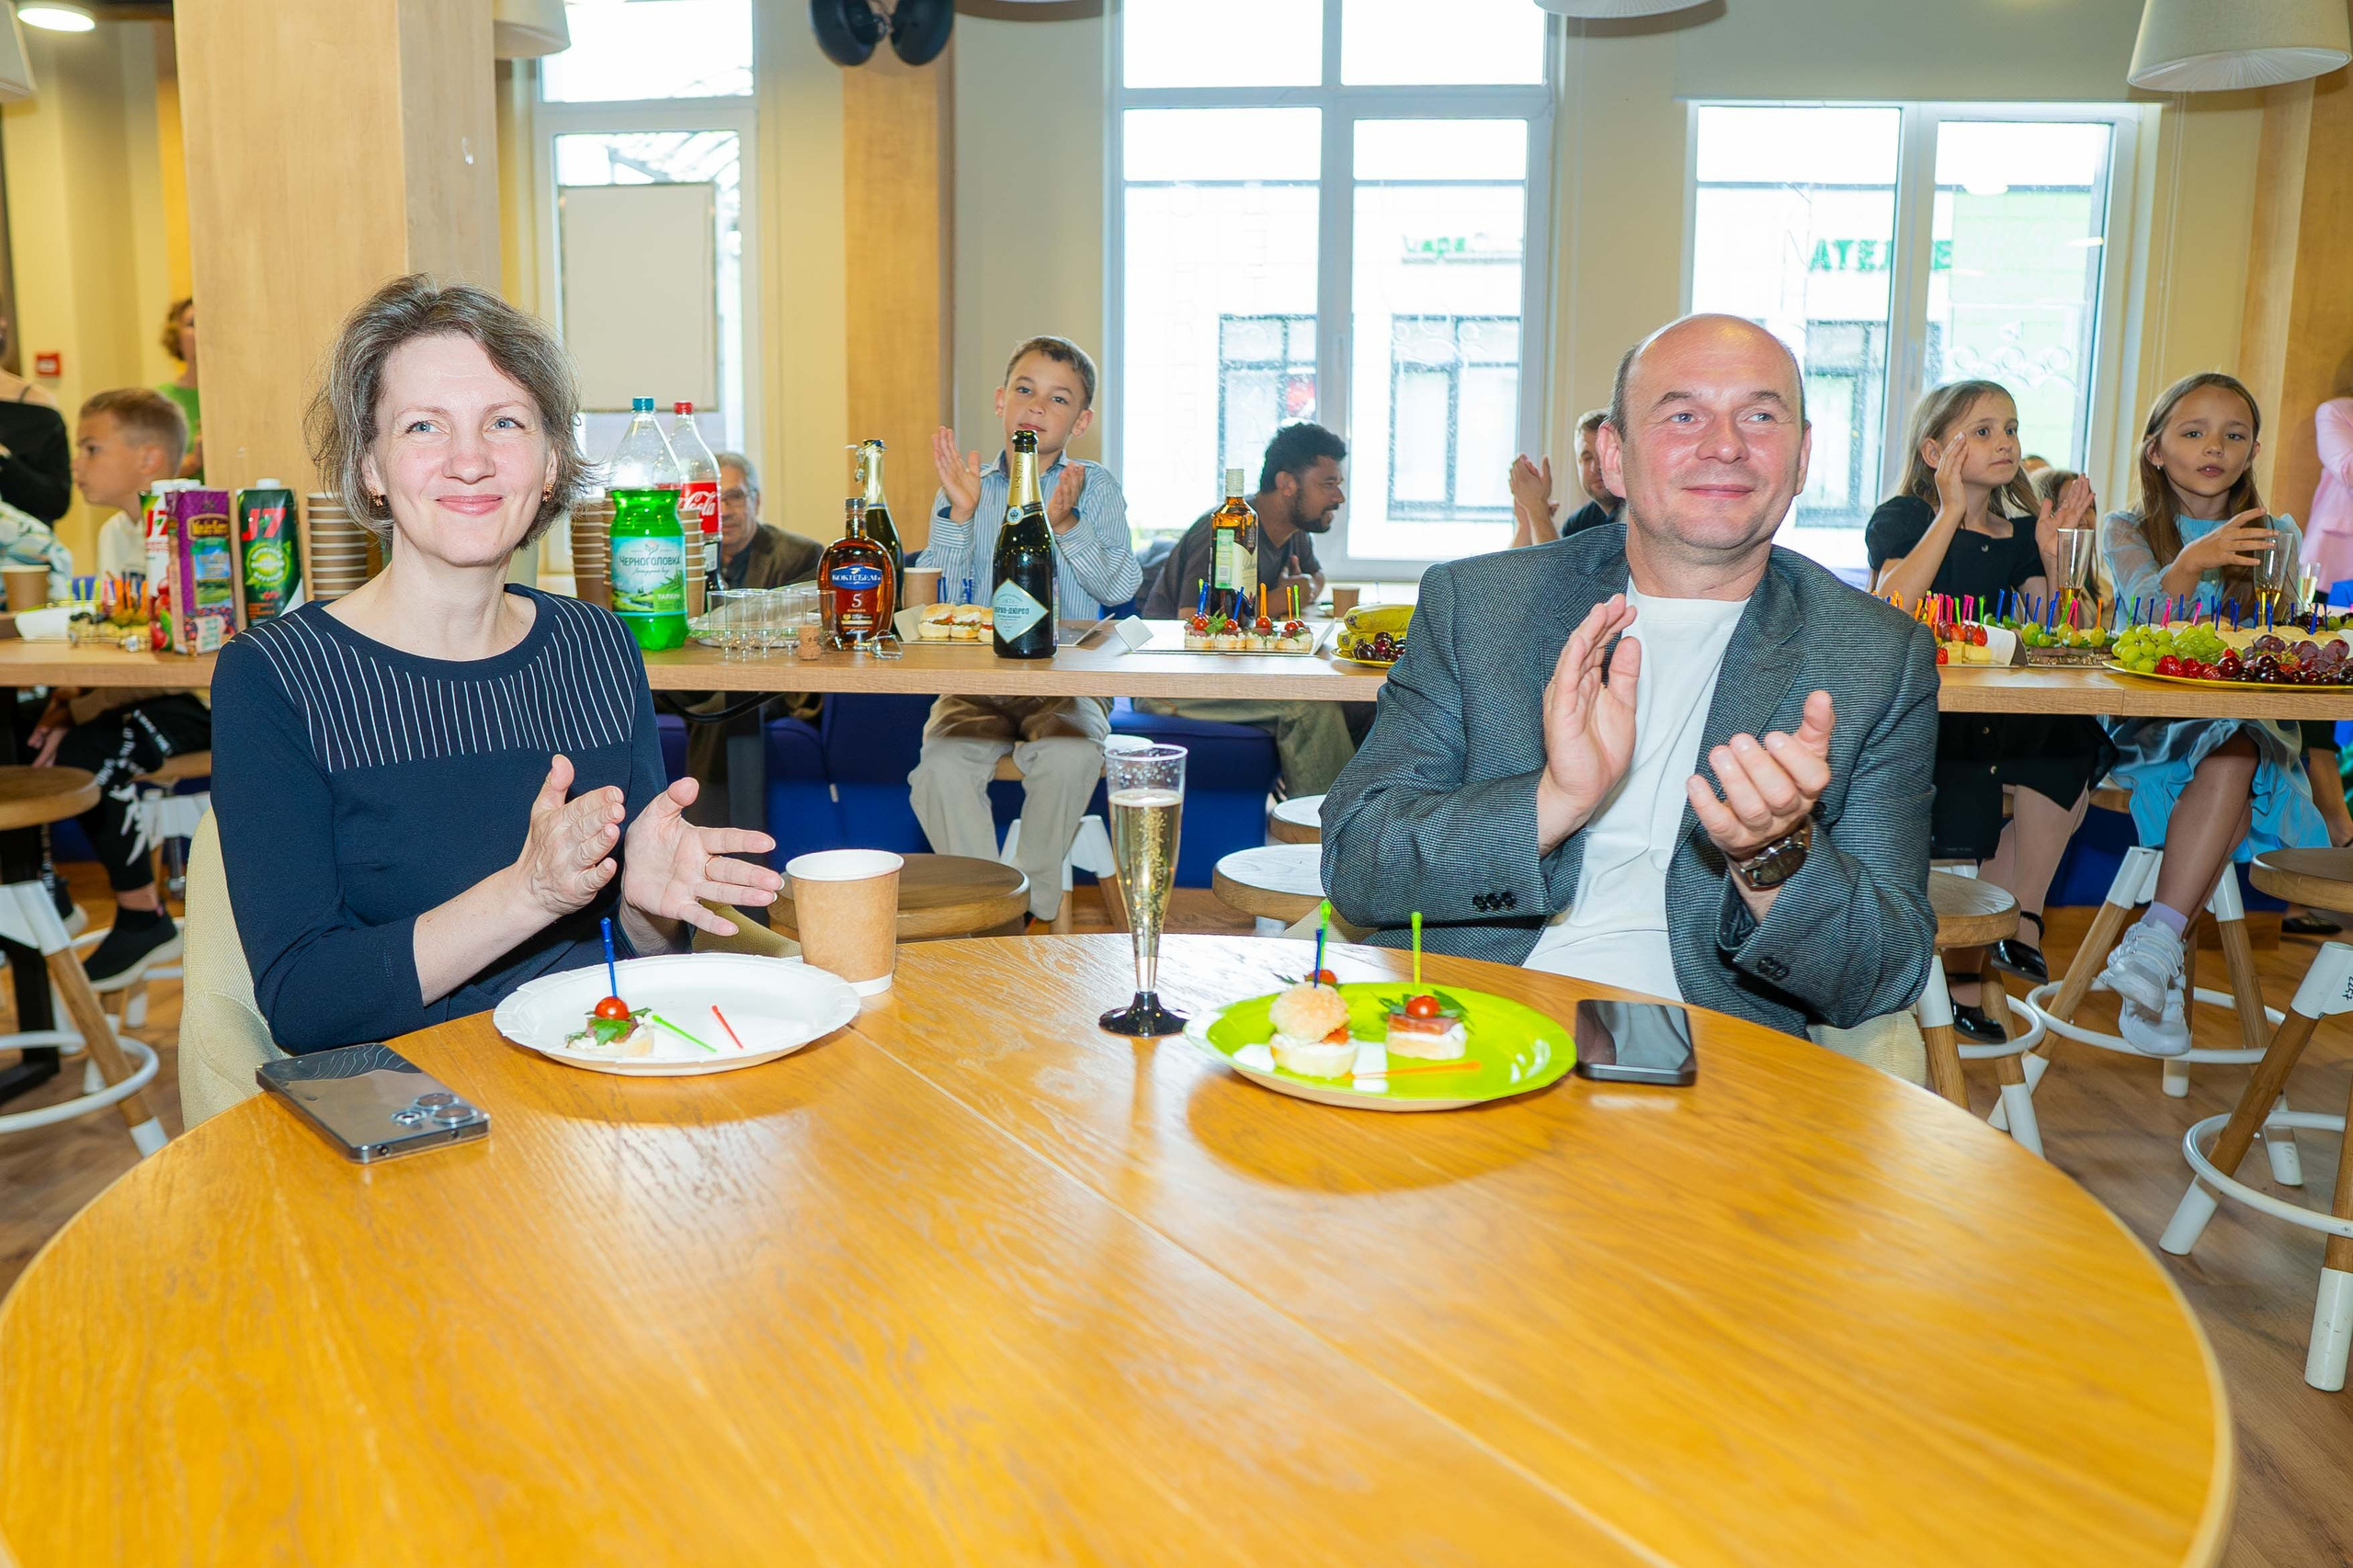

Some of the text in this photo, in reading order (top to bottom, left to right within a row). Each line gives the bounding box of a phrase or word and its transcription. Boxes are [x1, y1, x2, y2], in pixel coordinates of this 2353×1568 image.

[241, 507, 287, 541] J7
[619, 555, 681, 566] ЧЕРНОГОЛОВКА
[851, 593, 862, 608] 5
